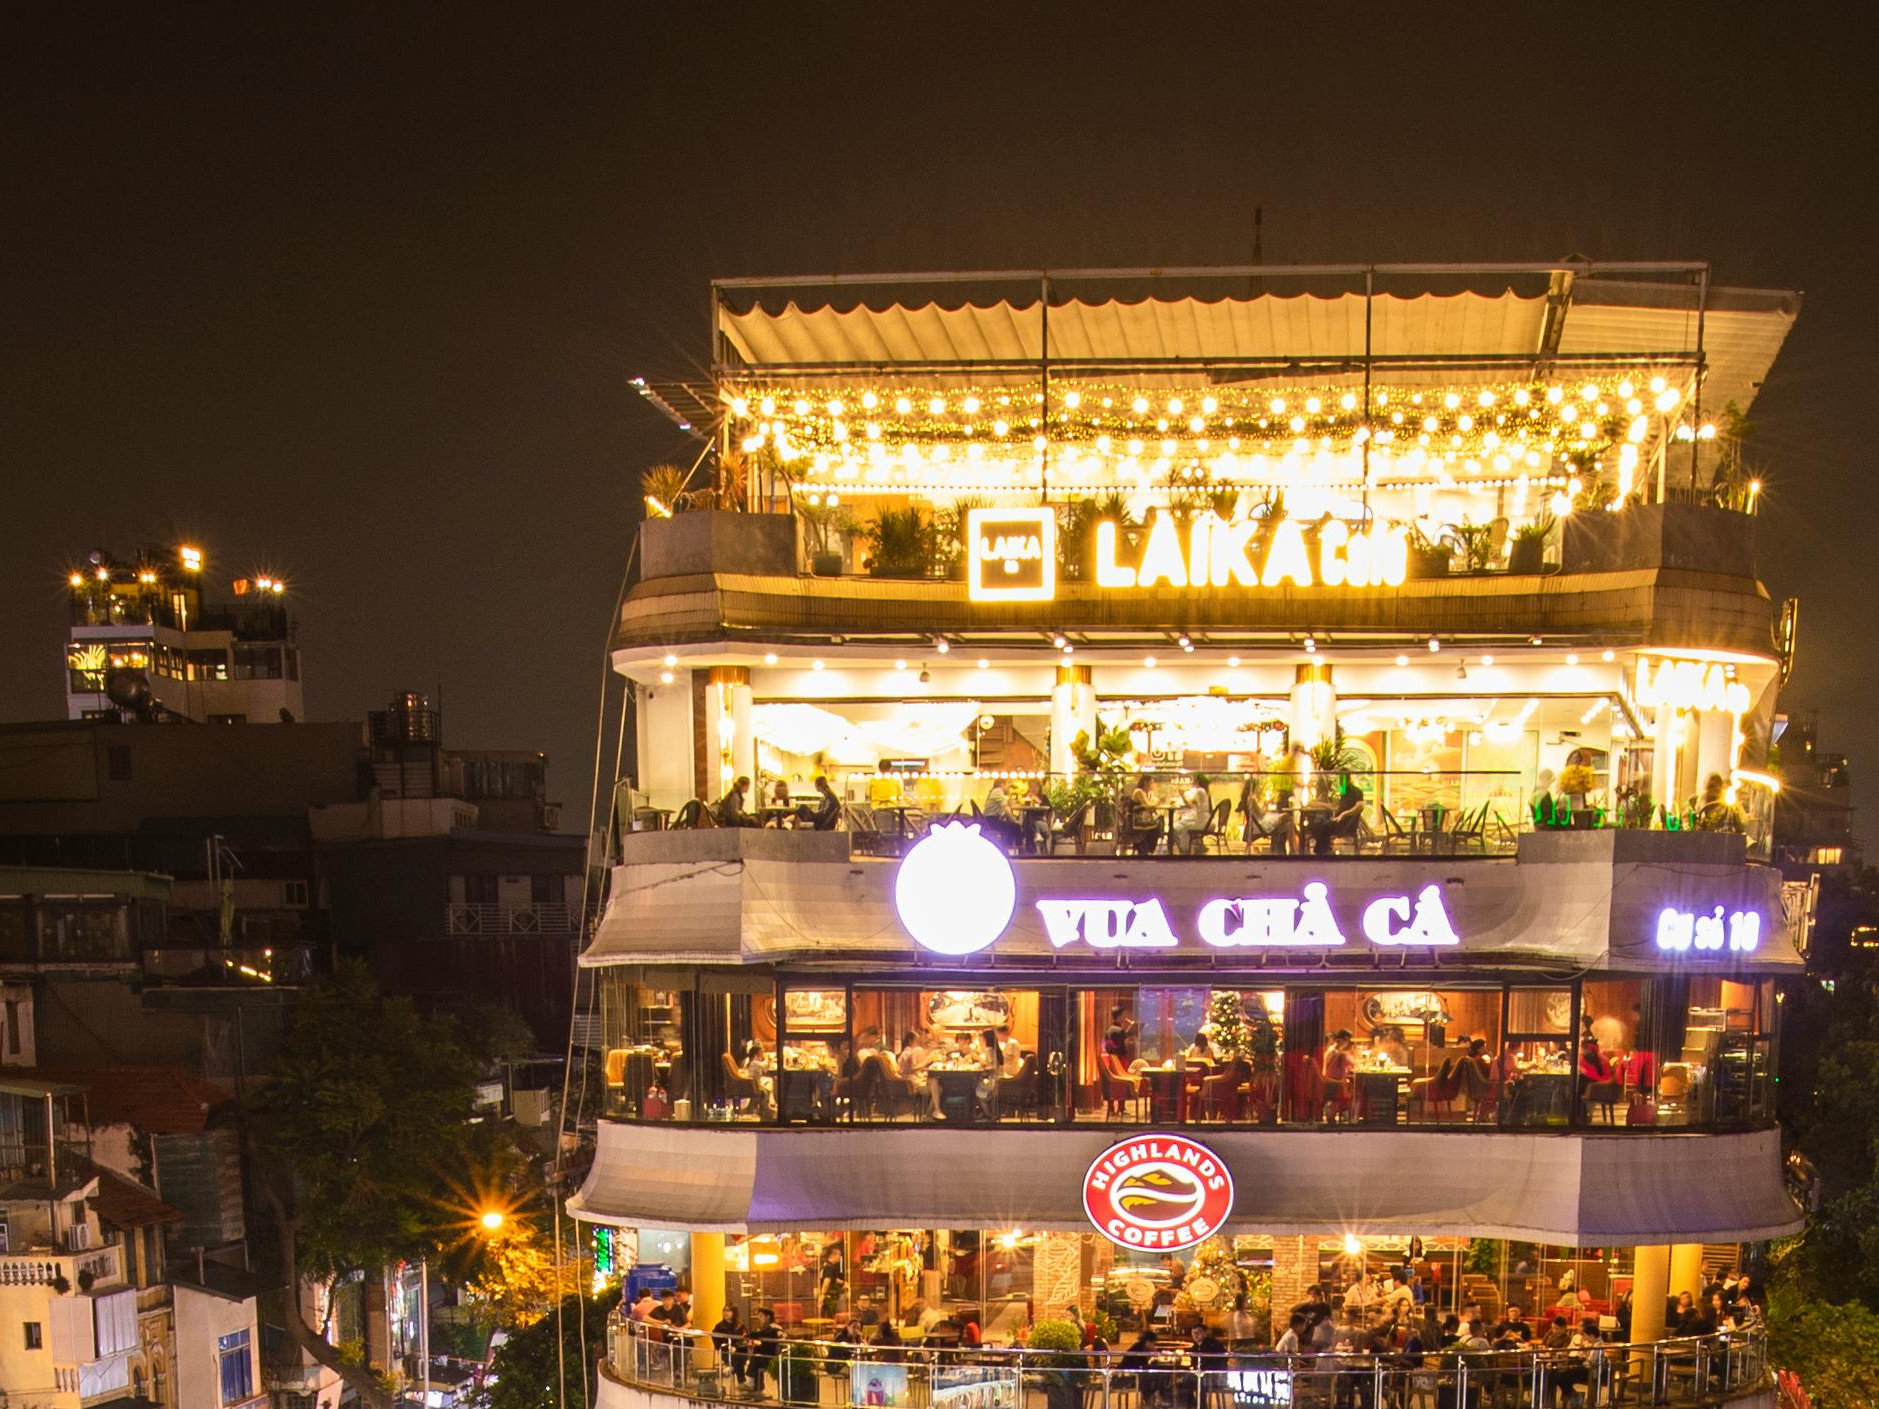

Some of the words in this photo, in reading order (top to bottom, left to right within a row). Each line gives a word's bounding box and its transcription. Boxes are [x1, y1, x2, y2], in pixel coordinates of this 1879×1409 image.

[981, 536, 1042, 560] LAIKA
[1096, 514, 1314, 587] LAIKA
[1038, 897, 1177, 949] VUA
[1364, 884, 1460, 949] CÁ
[1090, 1140, 1225, 1191] HIGHLANDS
[1108, 1214, 1210, 1246] COFFEE
